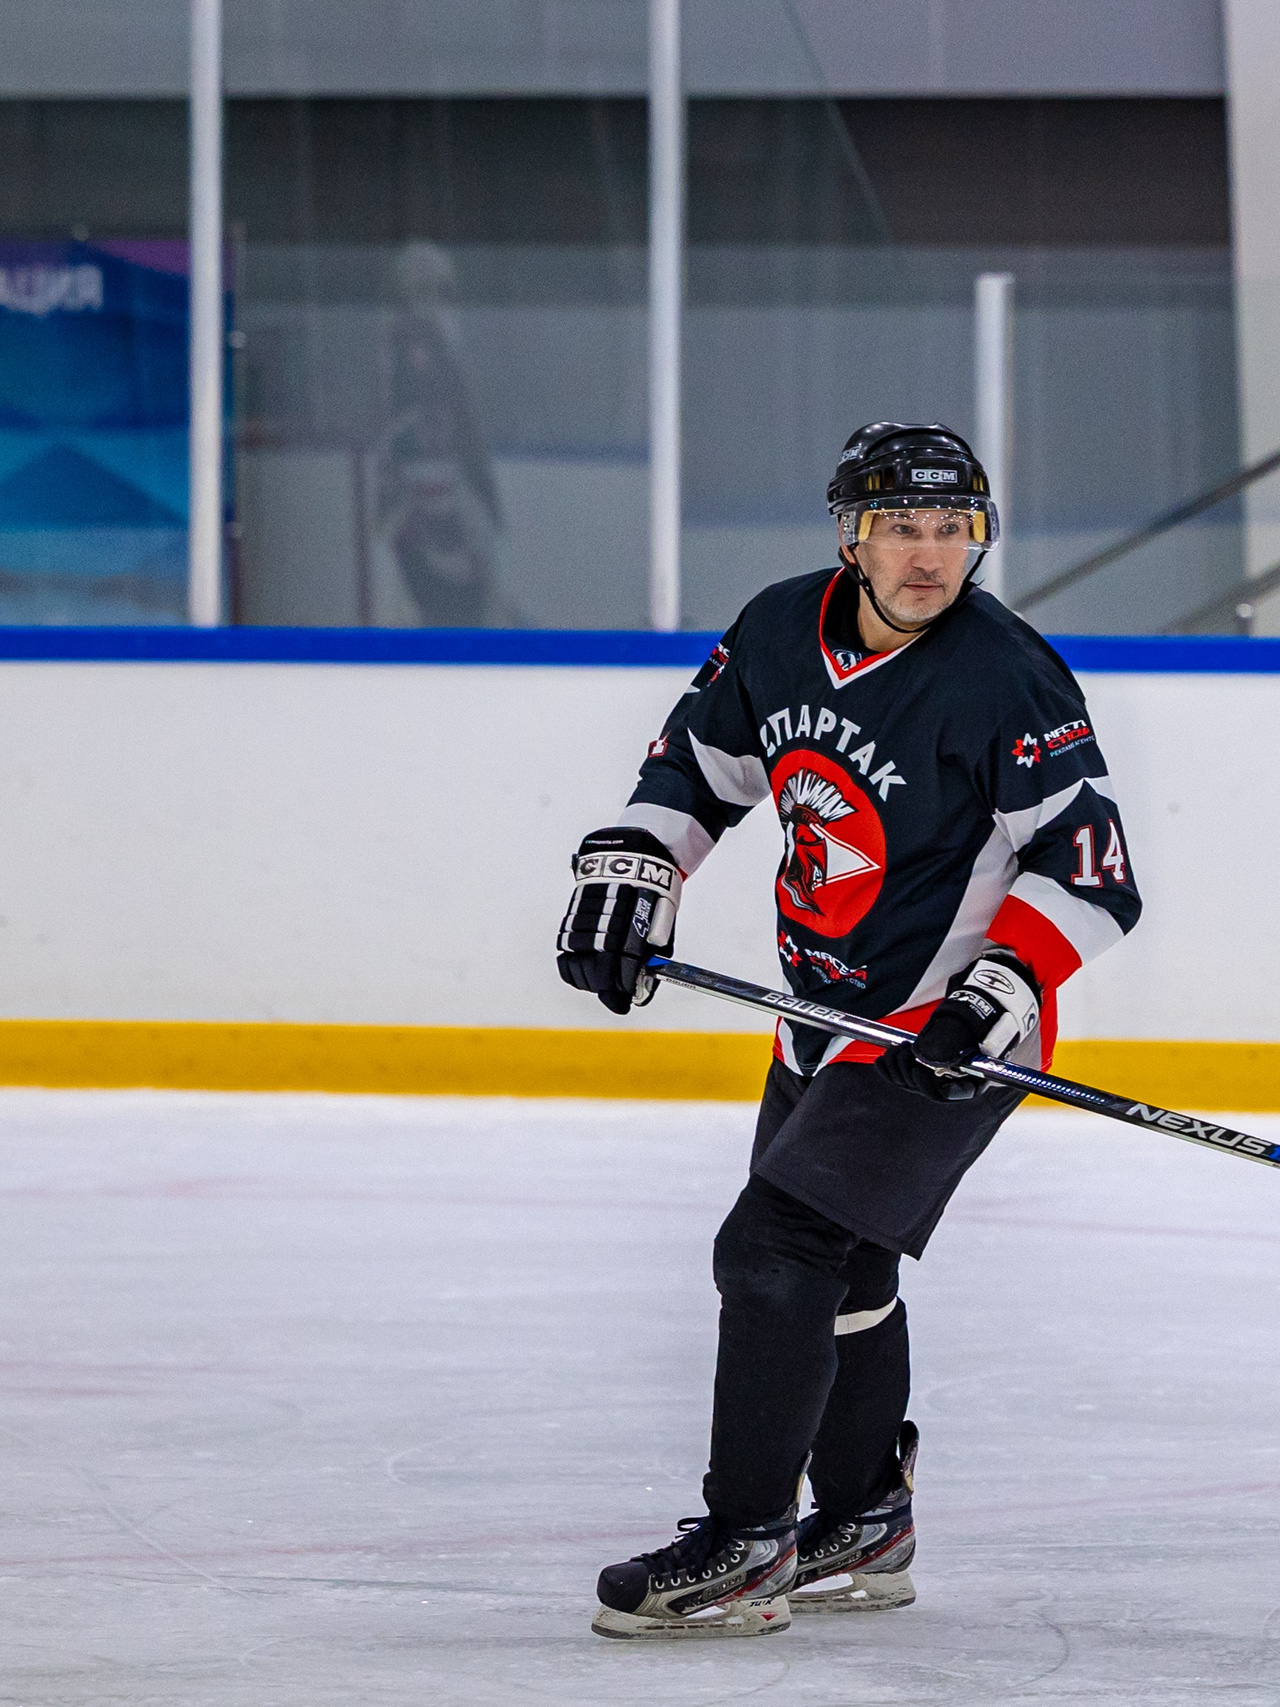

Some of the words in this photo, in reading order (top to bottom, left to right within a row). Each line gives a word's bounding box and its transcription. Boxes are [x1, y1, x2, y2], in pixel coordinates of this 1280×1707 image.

[915, 470, 956, 481] CCM
[580, 857, 671, 888] CCM
[1071, 819, 1125, 888] 14
[1126, 1103, 1272, 1155] NEXUS
